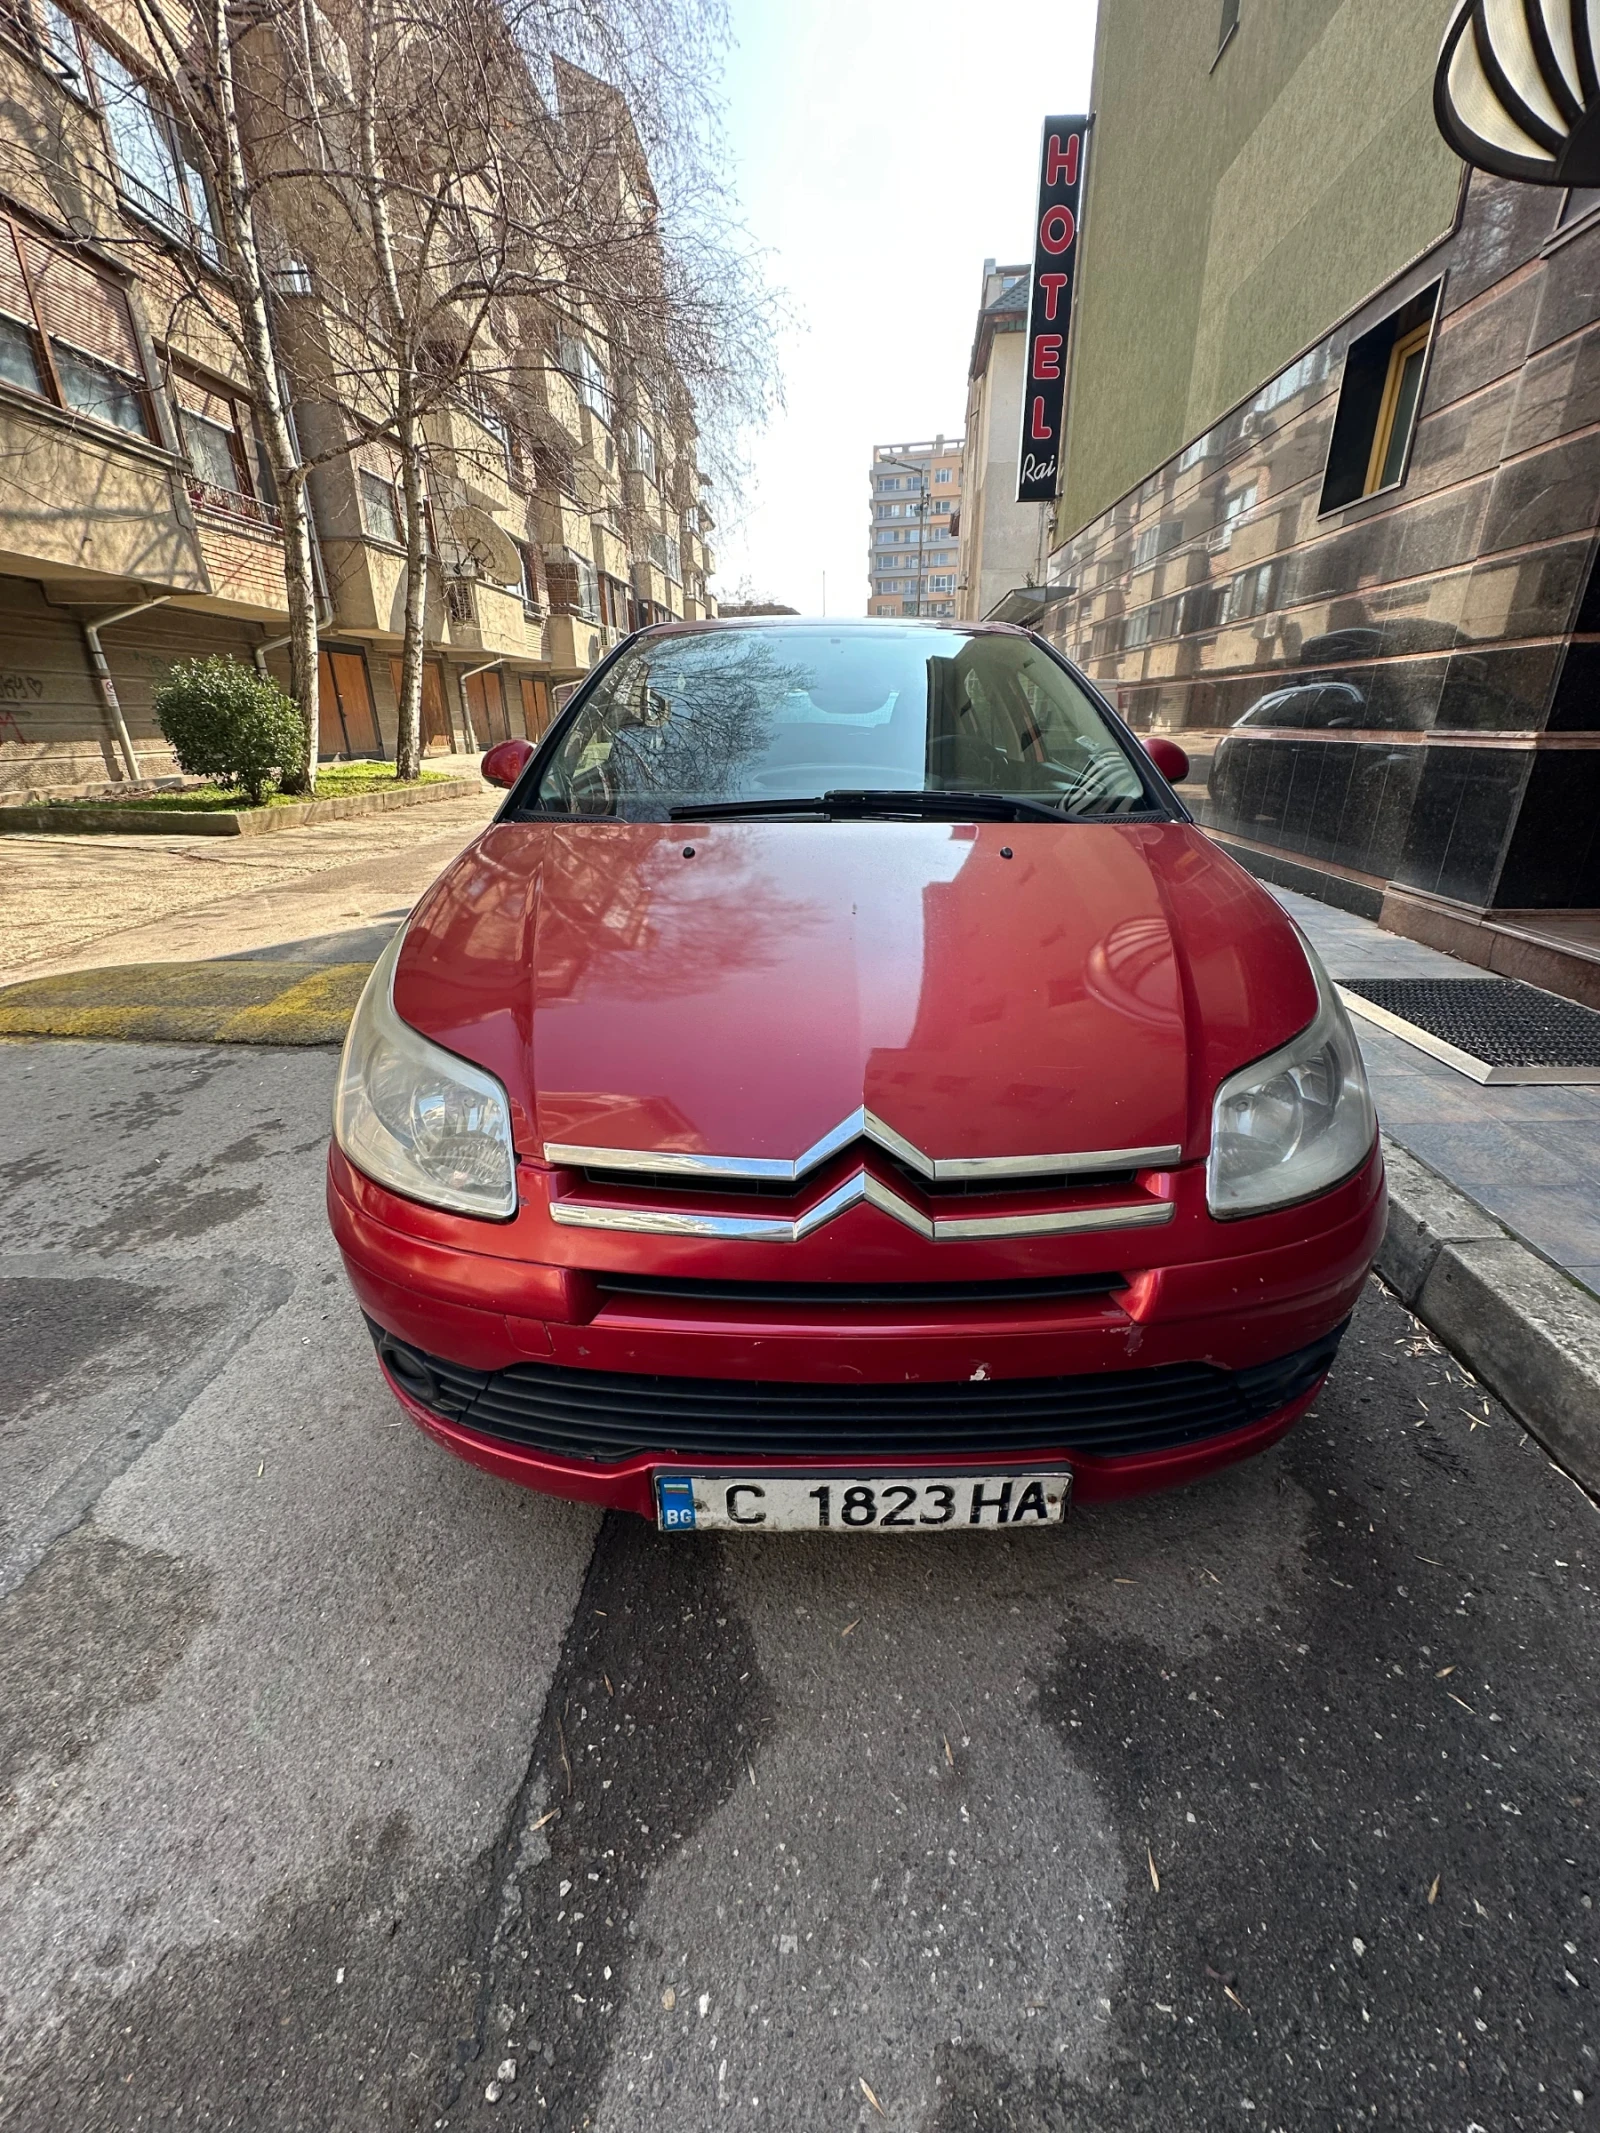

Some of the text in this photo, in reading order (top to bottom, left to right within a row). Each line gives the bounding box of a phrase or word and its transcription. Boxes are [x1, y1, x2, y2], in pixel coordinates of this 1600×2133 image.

[1031, 133, 1080, 440] HOTEL
[1021, 454, 1056, 484] Rai
[666, 1509, 693, 1525] BG
[725, 1481, 1049, 1527] C 1823 HA
